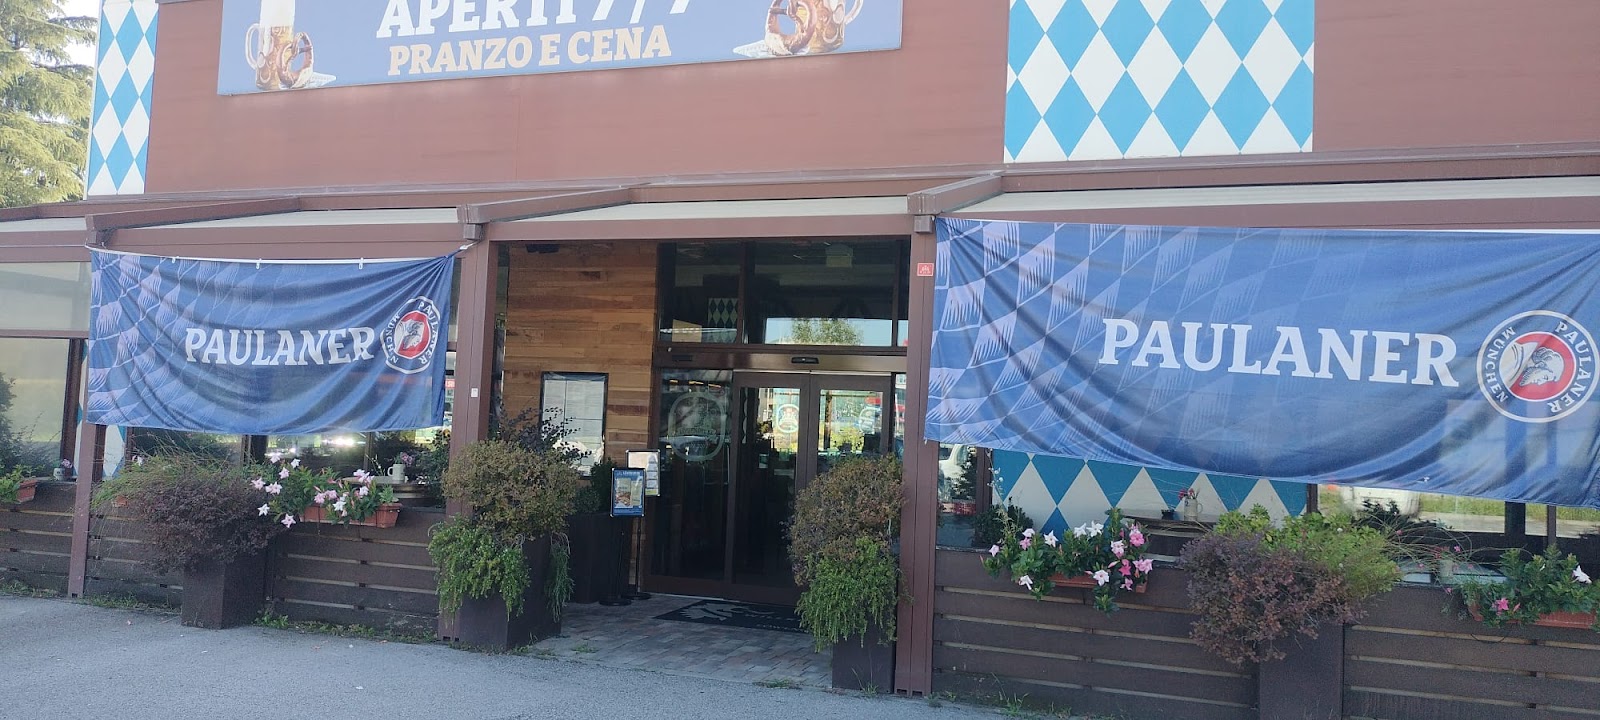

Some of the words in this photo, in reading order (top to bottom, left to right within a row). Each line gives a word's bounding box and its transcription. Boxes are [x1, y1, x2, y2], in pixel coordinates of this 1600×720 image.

[388, 36, 532, 76] PRANZO
[539, 34, 561, 66] E
[568, 25, 672, 64] CENA
[185, 327, 375, 366] PAULANER
[1098, 318, 1459, 387] PAULANER
[1485, 326, 1516, 402] MÜNCHEN
[1547, 321, 1592, 413] PAULANER
